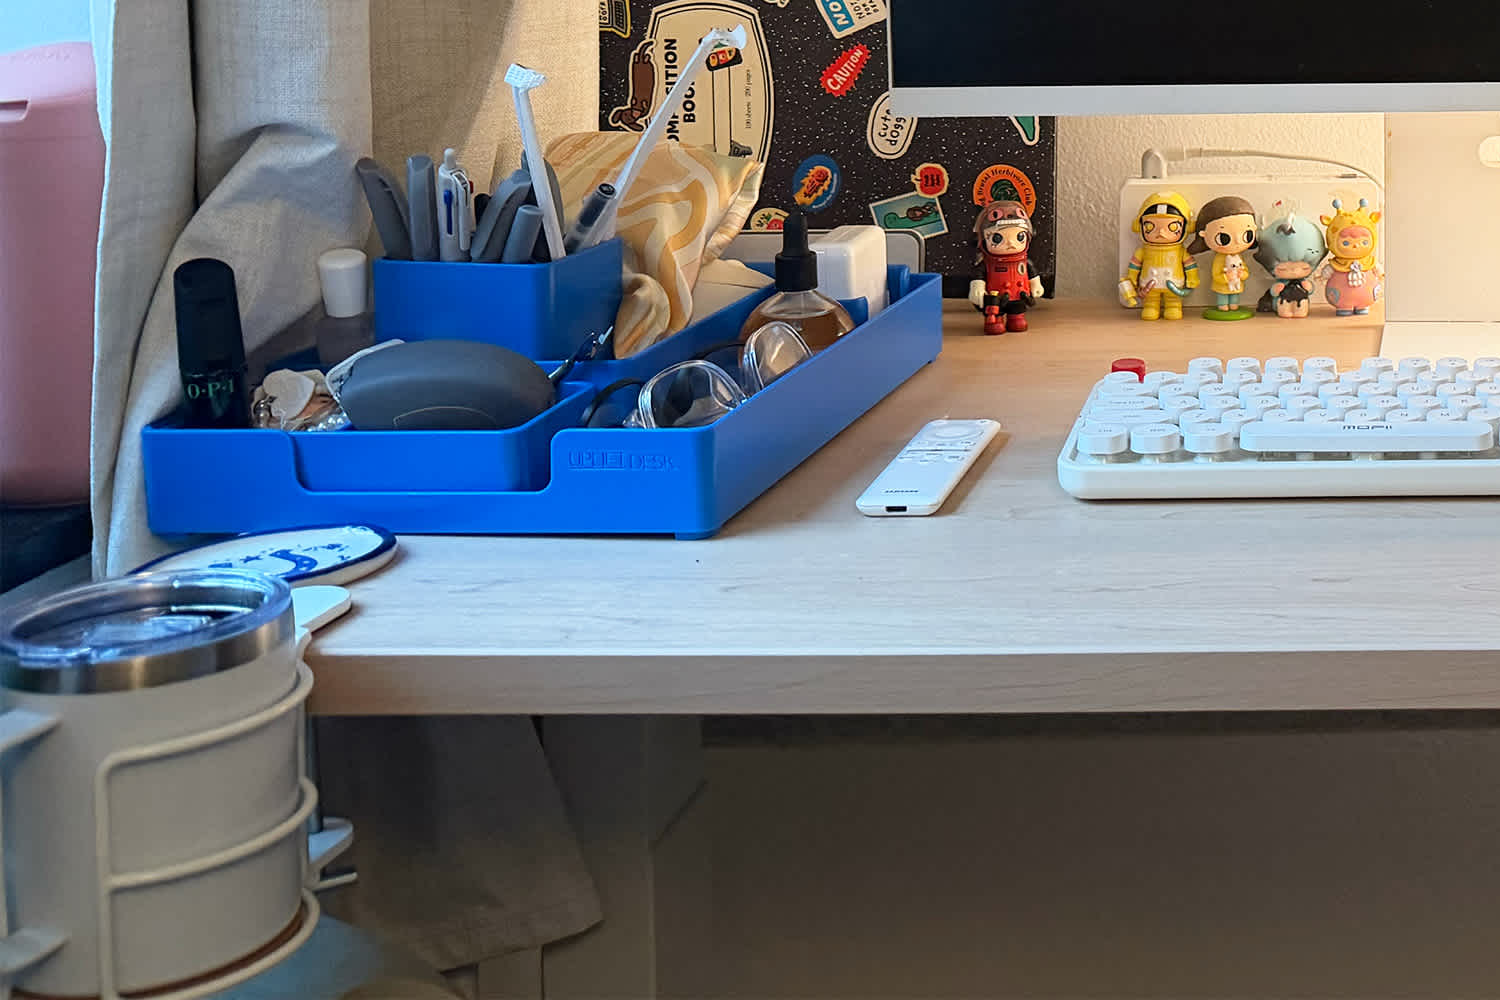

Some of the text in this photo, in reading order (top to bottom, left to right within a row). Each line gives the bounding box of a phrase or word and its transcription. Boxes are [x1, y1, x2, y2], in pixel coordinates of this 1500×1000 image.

[850, 1, 865, 19] NOT
[827, 48, 863, 90] CAUTION
[682, 81, 696, 123] BOO
[886, 117, 907, 146] dogg
